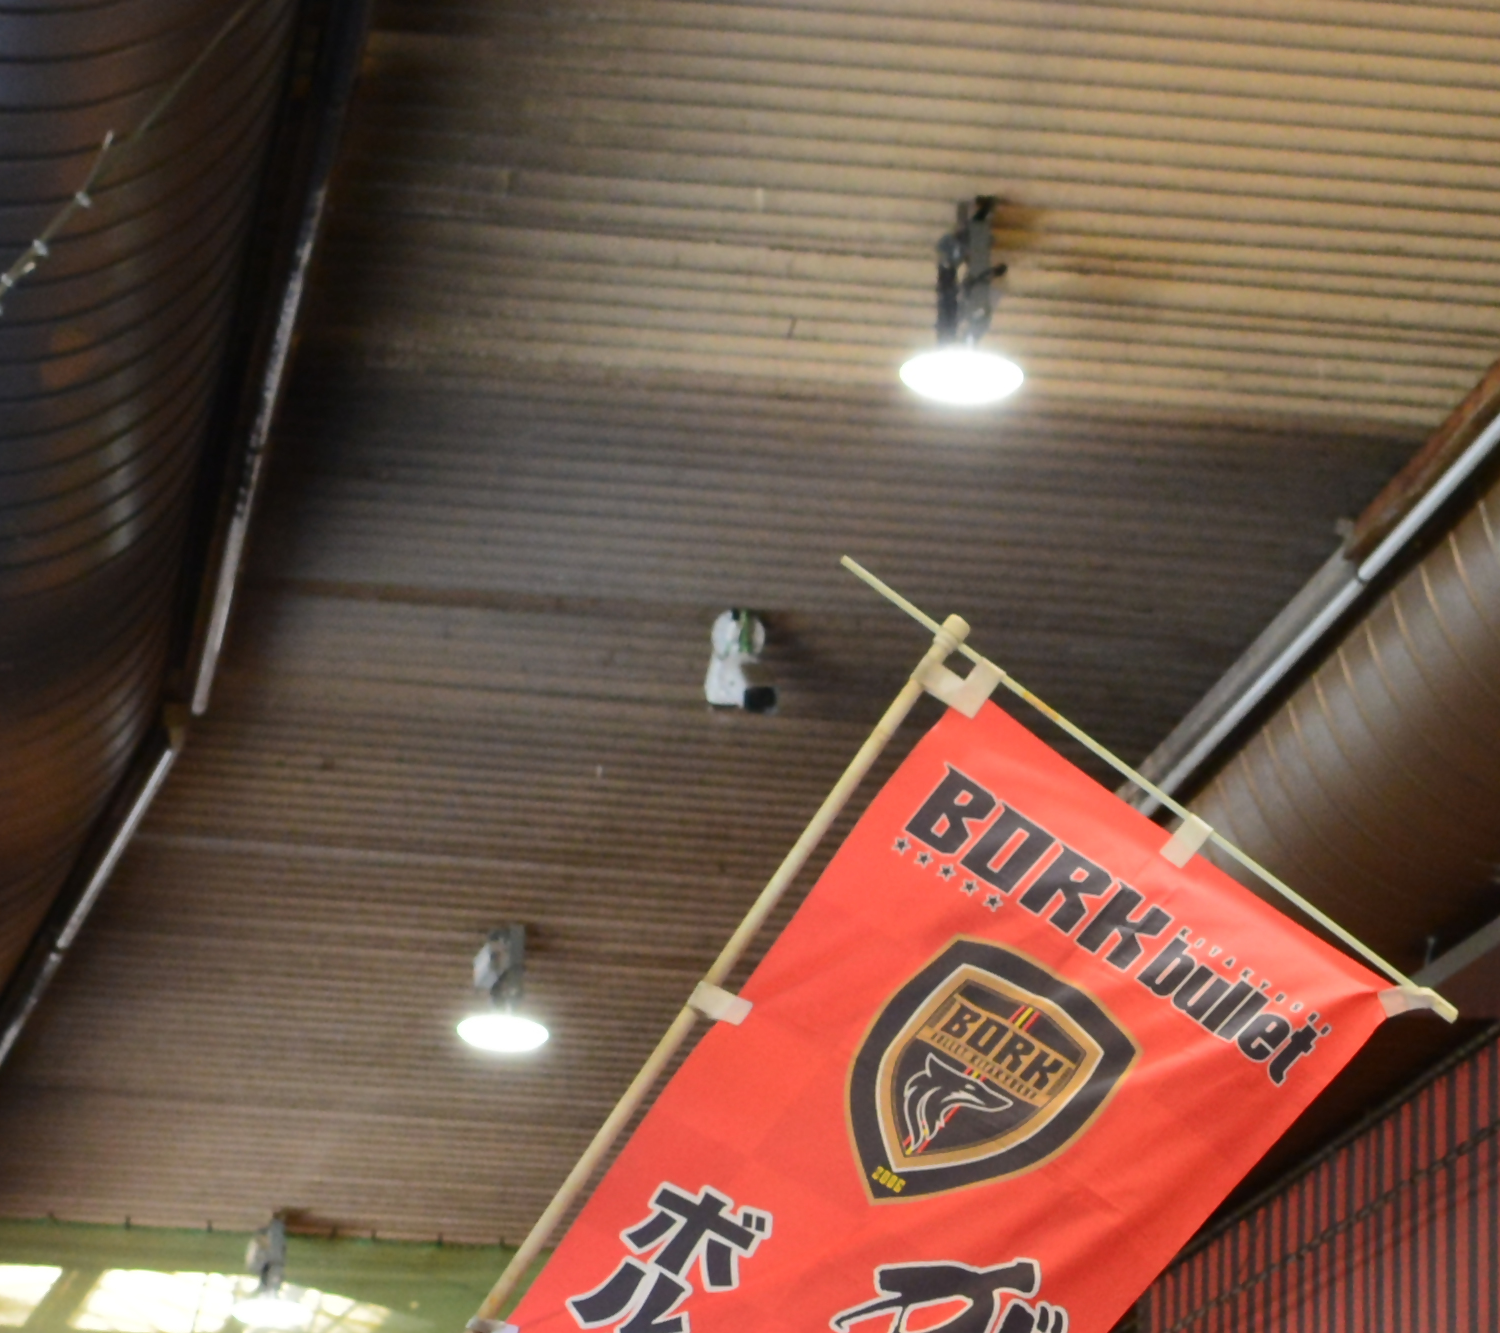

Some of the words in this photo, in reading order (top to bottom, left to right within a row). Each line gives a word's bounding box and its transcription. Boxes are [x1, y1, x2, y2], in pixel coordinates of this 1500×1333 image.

[903, 761, 1175, 972] BORK
[1135, 936, 1332, 1087] bullet
[941, 1005, 1064, 1091] BORK
[871, 1165, 907, 1195] 2006
